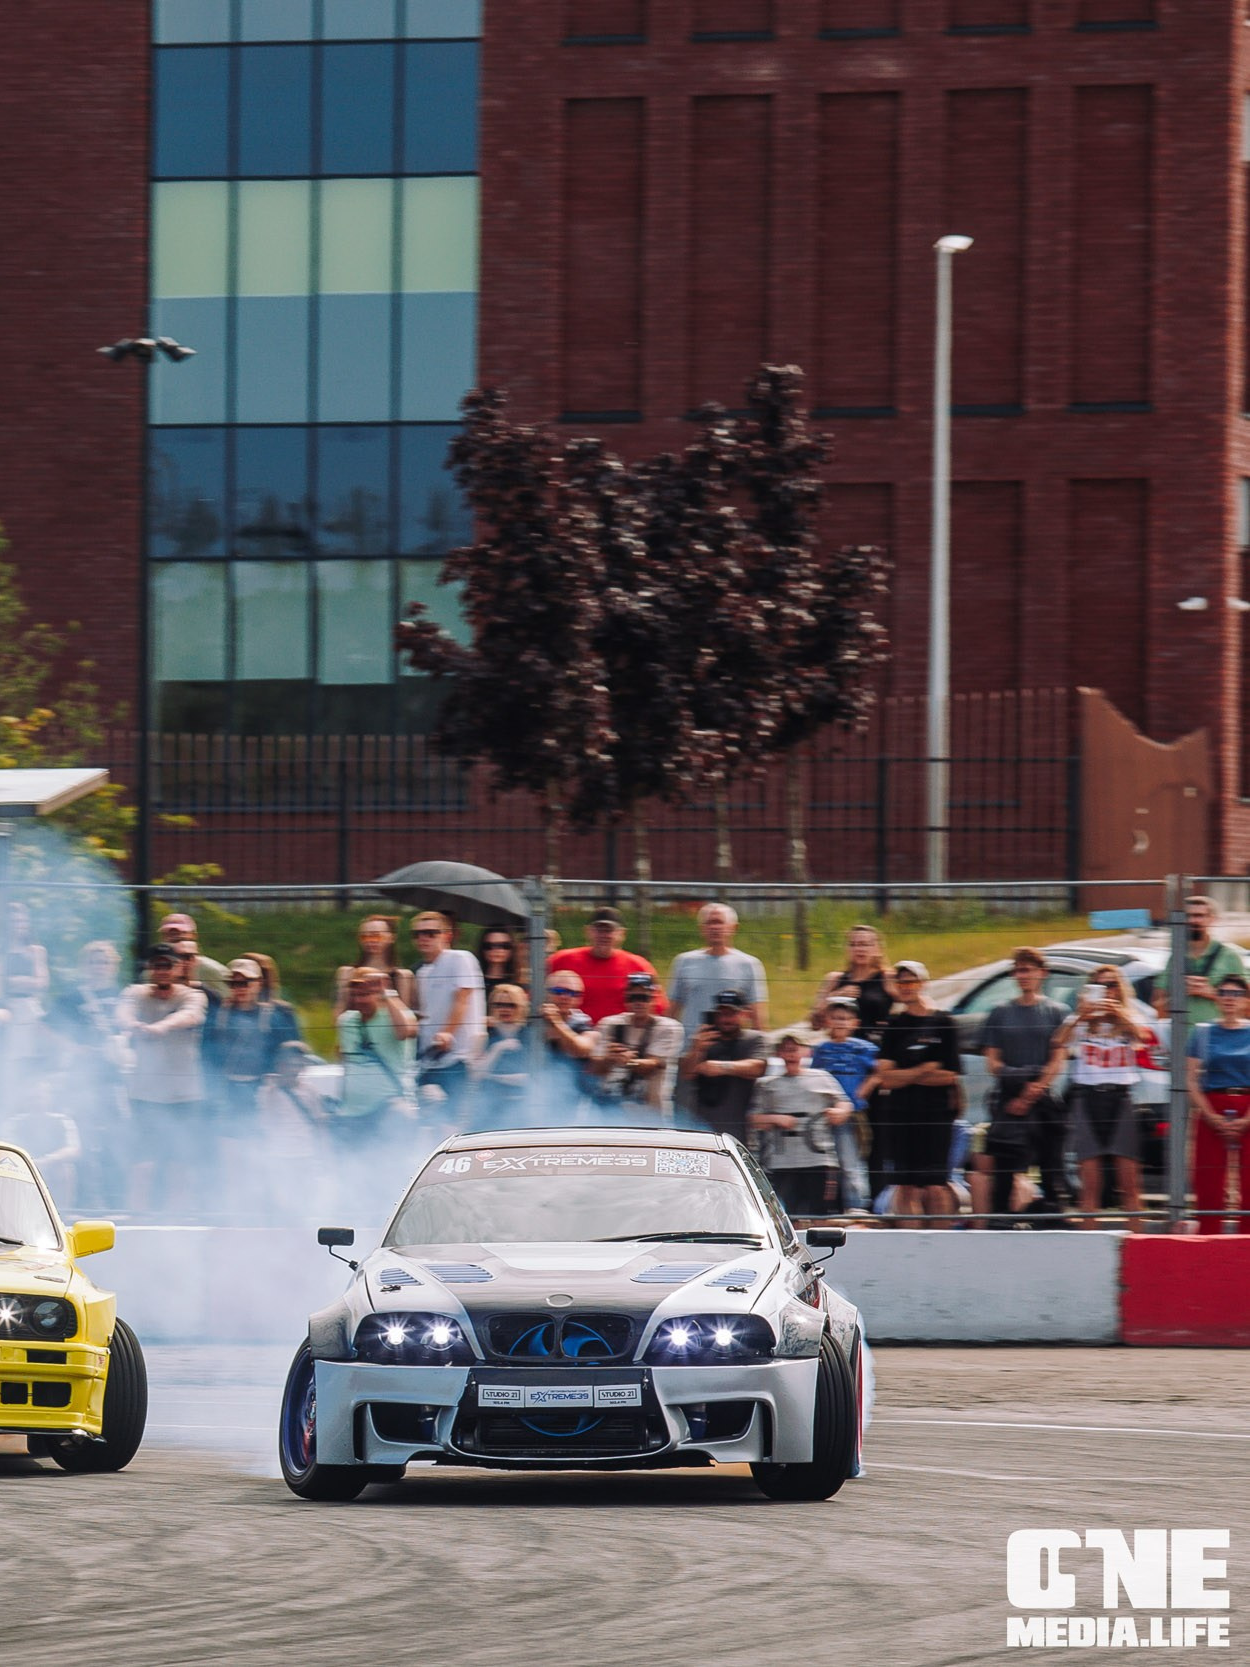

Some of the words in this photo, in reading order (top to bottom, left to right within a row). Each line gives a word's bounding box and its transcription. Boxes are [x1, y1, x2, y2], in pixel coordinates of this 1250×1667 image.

[438, 1156, 472, 1174] 46
[483, 1153, 648, 1175] EXTREME39
[530, 1390, 589, 1403] EXTREME39
